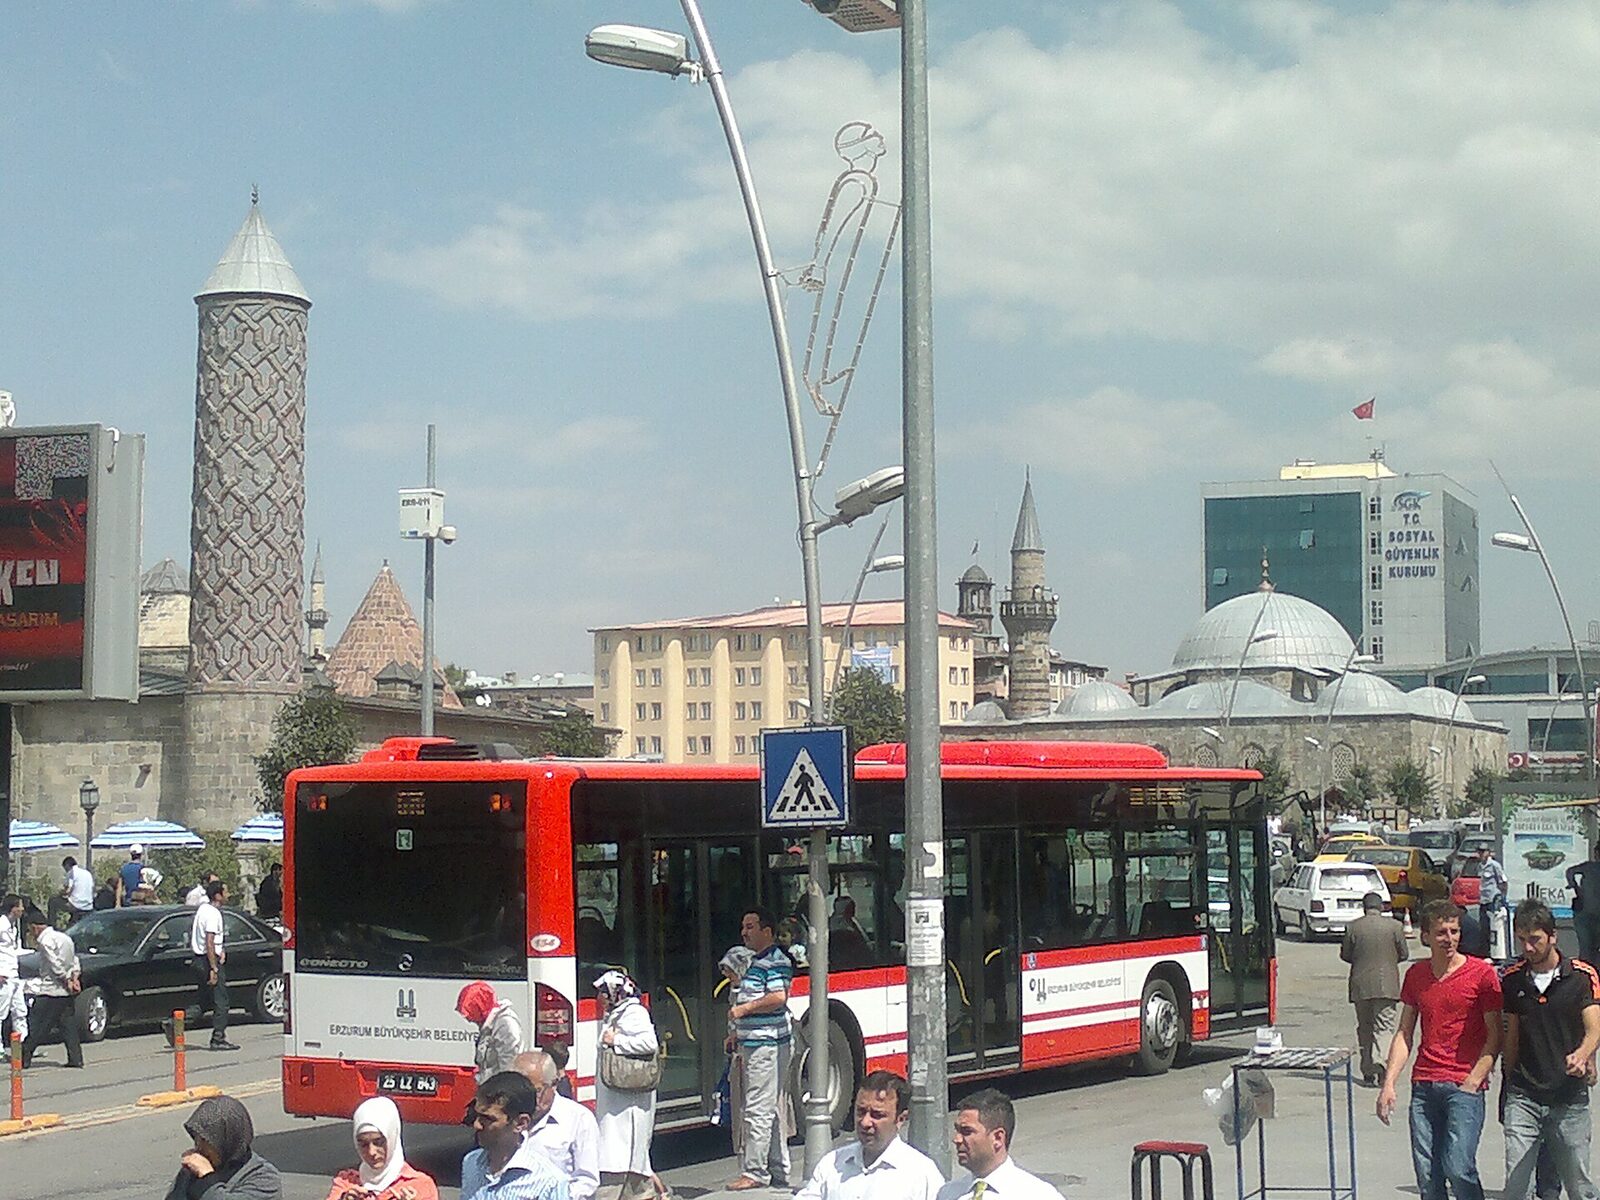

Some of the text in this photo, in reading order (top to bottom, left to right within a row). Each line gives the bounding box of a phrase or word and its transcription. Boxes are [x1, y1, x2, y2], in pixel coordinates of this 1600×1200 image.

[1388, 531, 1435, 543] SOSYAL
[1385, 546, 1440, 561] GÜVENLİK
[1388, 565, 1436, 578] KURUMU
[329, 1024, 372, 1037] ERZURUM
[374, 1025, 432, 1041] BÜYÜKŞEHİR
[383, 1075, 396, 1089] 25
